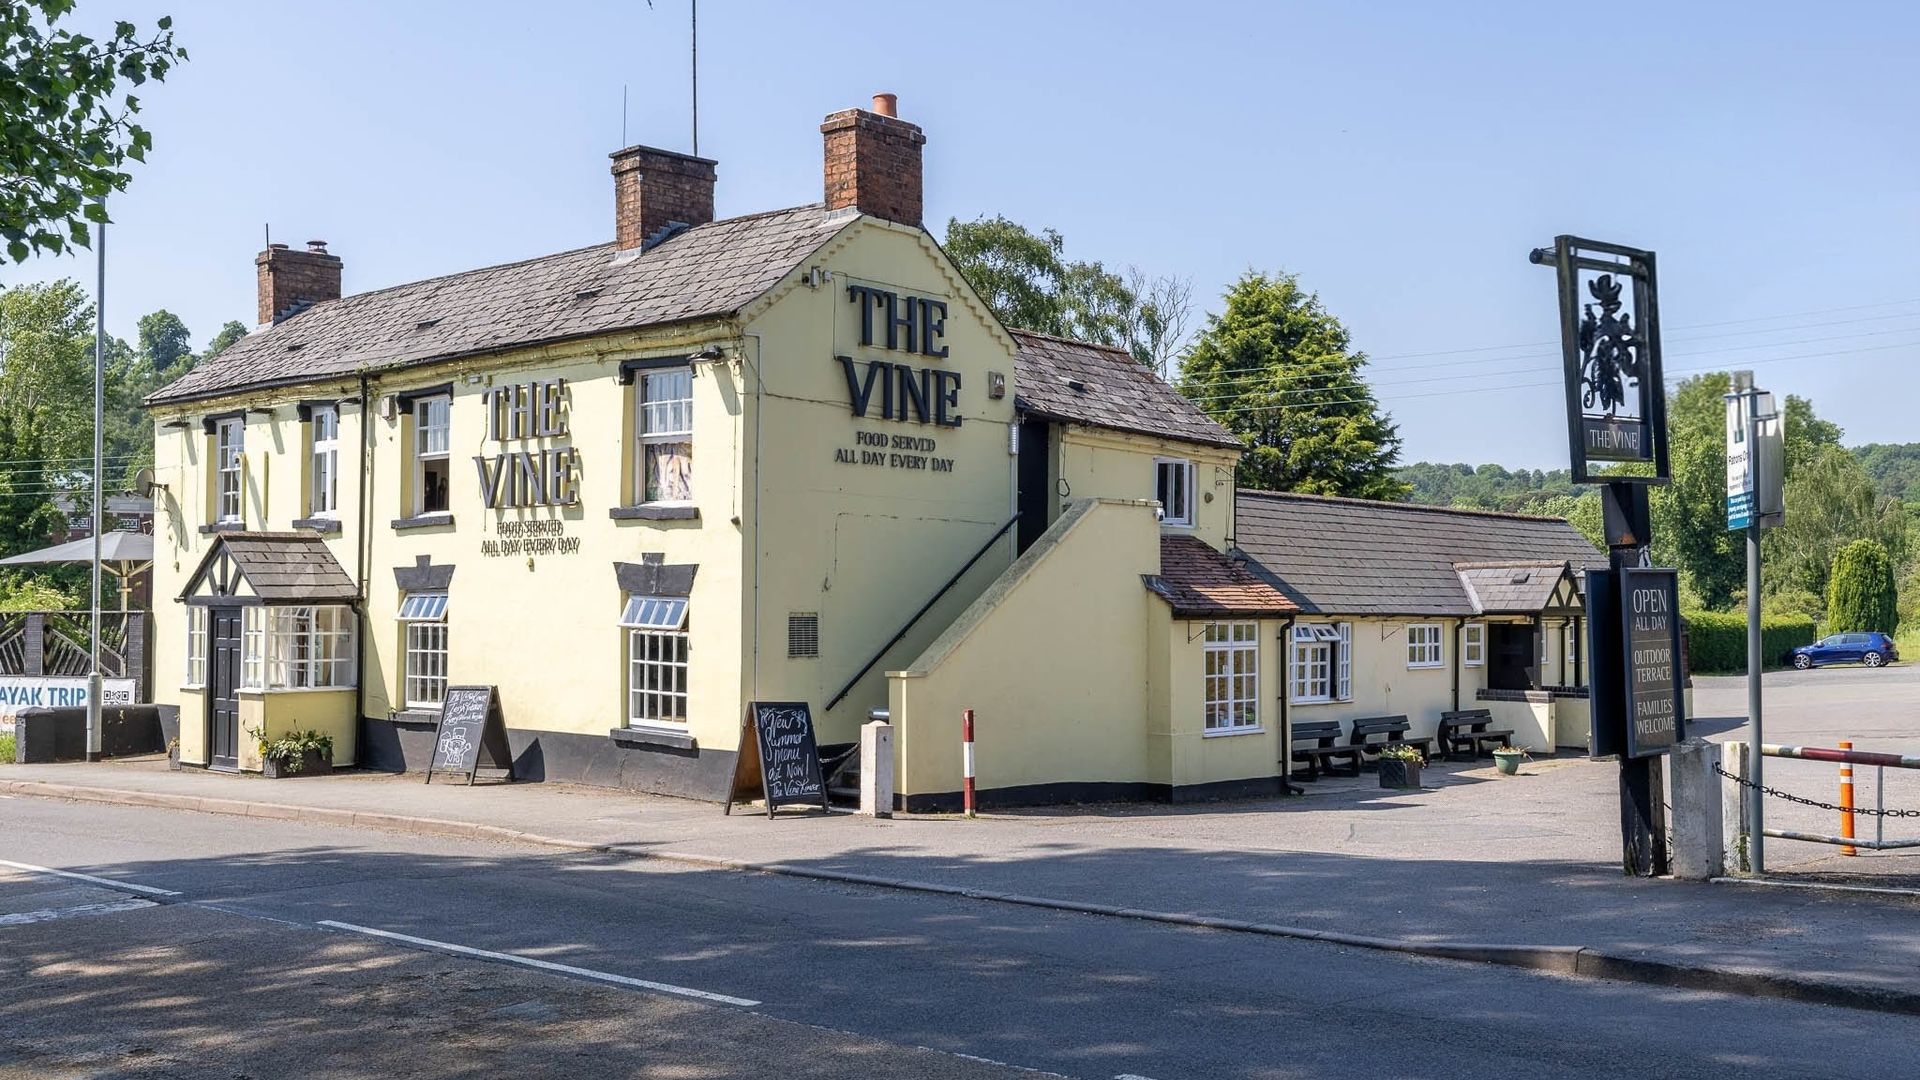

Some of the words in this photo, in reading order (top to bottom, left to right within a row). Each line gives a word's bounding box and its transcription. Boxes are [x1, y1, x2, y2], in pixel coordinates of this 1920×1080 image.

[850, 285, 948, 358] THE
[838, 356, 962, 427] VINE
[482, 378, 565, 441] THE
[856, 431, 888, 448] FOOD
[891, 435, 936, 452] SERVED
[1589, 429, 1610, 448] THE
[1612, 431, 1638, 450] VINE
[835, 448, 858, 464] ALL
[862, 451, 886, 466] DAY
[890, 454, 928, 470] EVERY
[932, 457, 954, 472] DAY
[472, 447, 576, 509] VINE
[497, 521, 522, 536] FOOD
[524, 520, 562, 535] SERVED
[481, 540, 499, 555] ALL
[501, 539, 521, 555] DAY
[523, 539, 555, 553] EVERY
[558, 537, 579, 553] DAY
[1633, 589, 1667, 613] OPEN
[1635, 617, 1650, 631] ALL
[1652, 616, 1667, 630] DAY
[1634, 649, 1671, 665] OUTDOOR
[1636, 666, 1671, 682] TERRACE
[1637, 699, 1673, 716] FAMILIES
[767, 712, 793, 738] New
[1636, 716, 1676, 734] WELCOME
[765, 727, 806, 761] Summer
